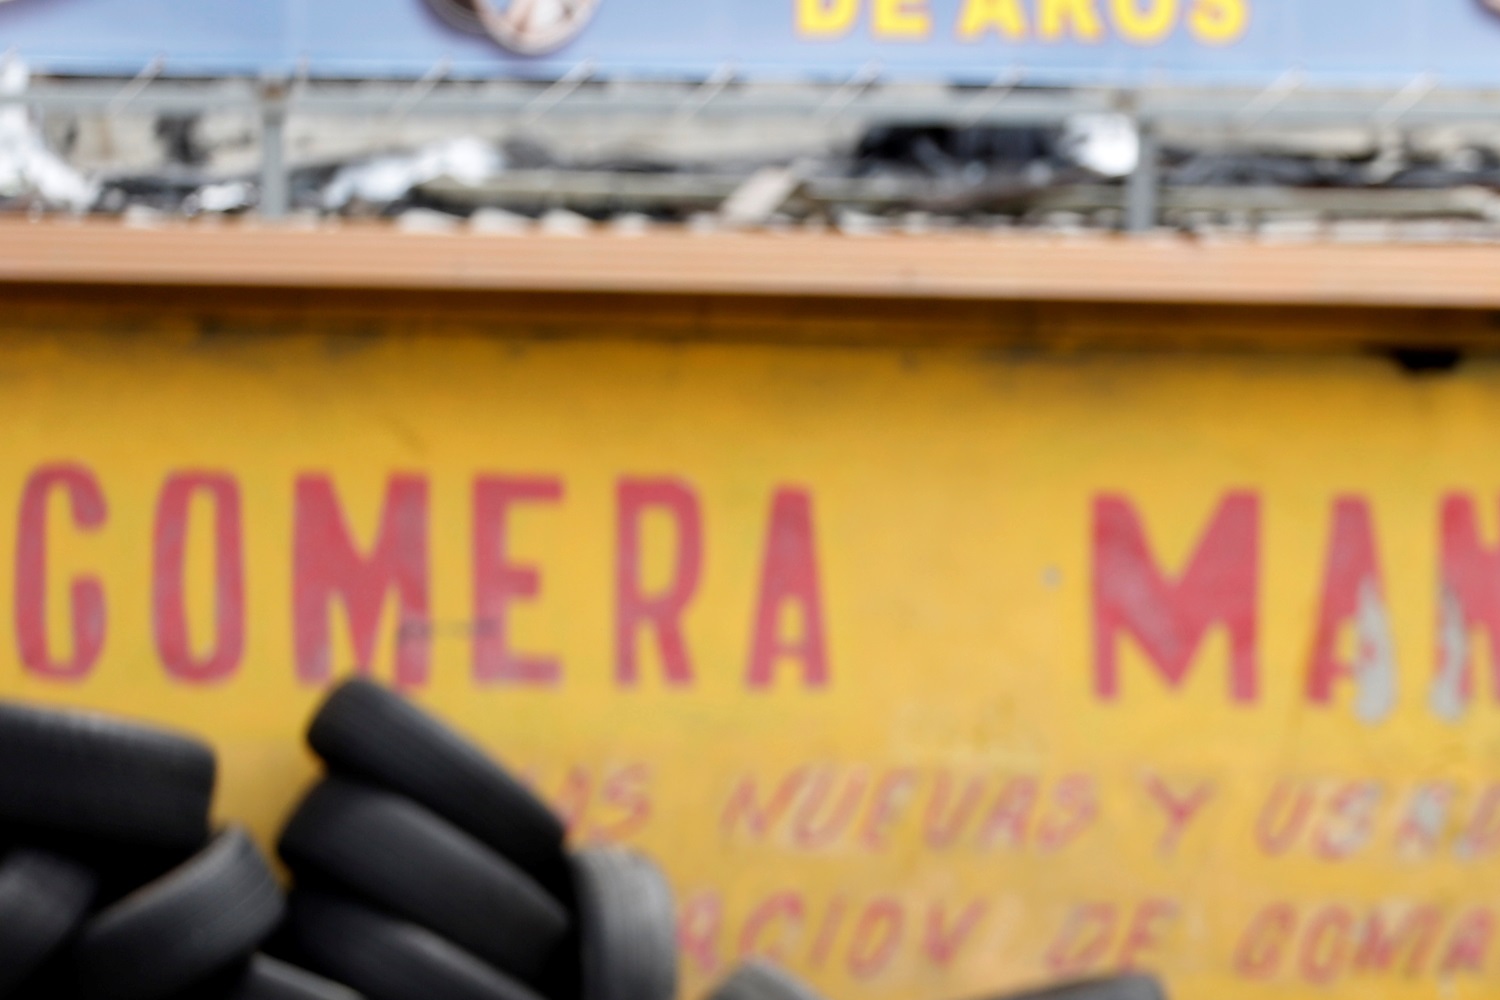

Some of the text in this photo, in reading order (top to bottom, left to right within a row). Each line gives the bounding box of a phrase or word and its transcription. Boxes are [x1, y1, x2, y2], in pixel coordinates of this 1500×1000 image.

[796, 0, 932, 37] DE
[717, 762, 1098, 857] NUEVAS
[1140, 766, 1216, 858] Y
[1045, 897, 1182, 976] DE
